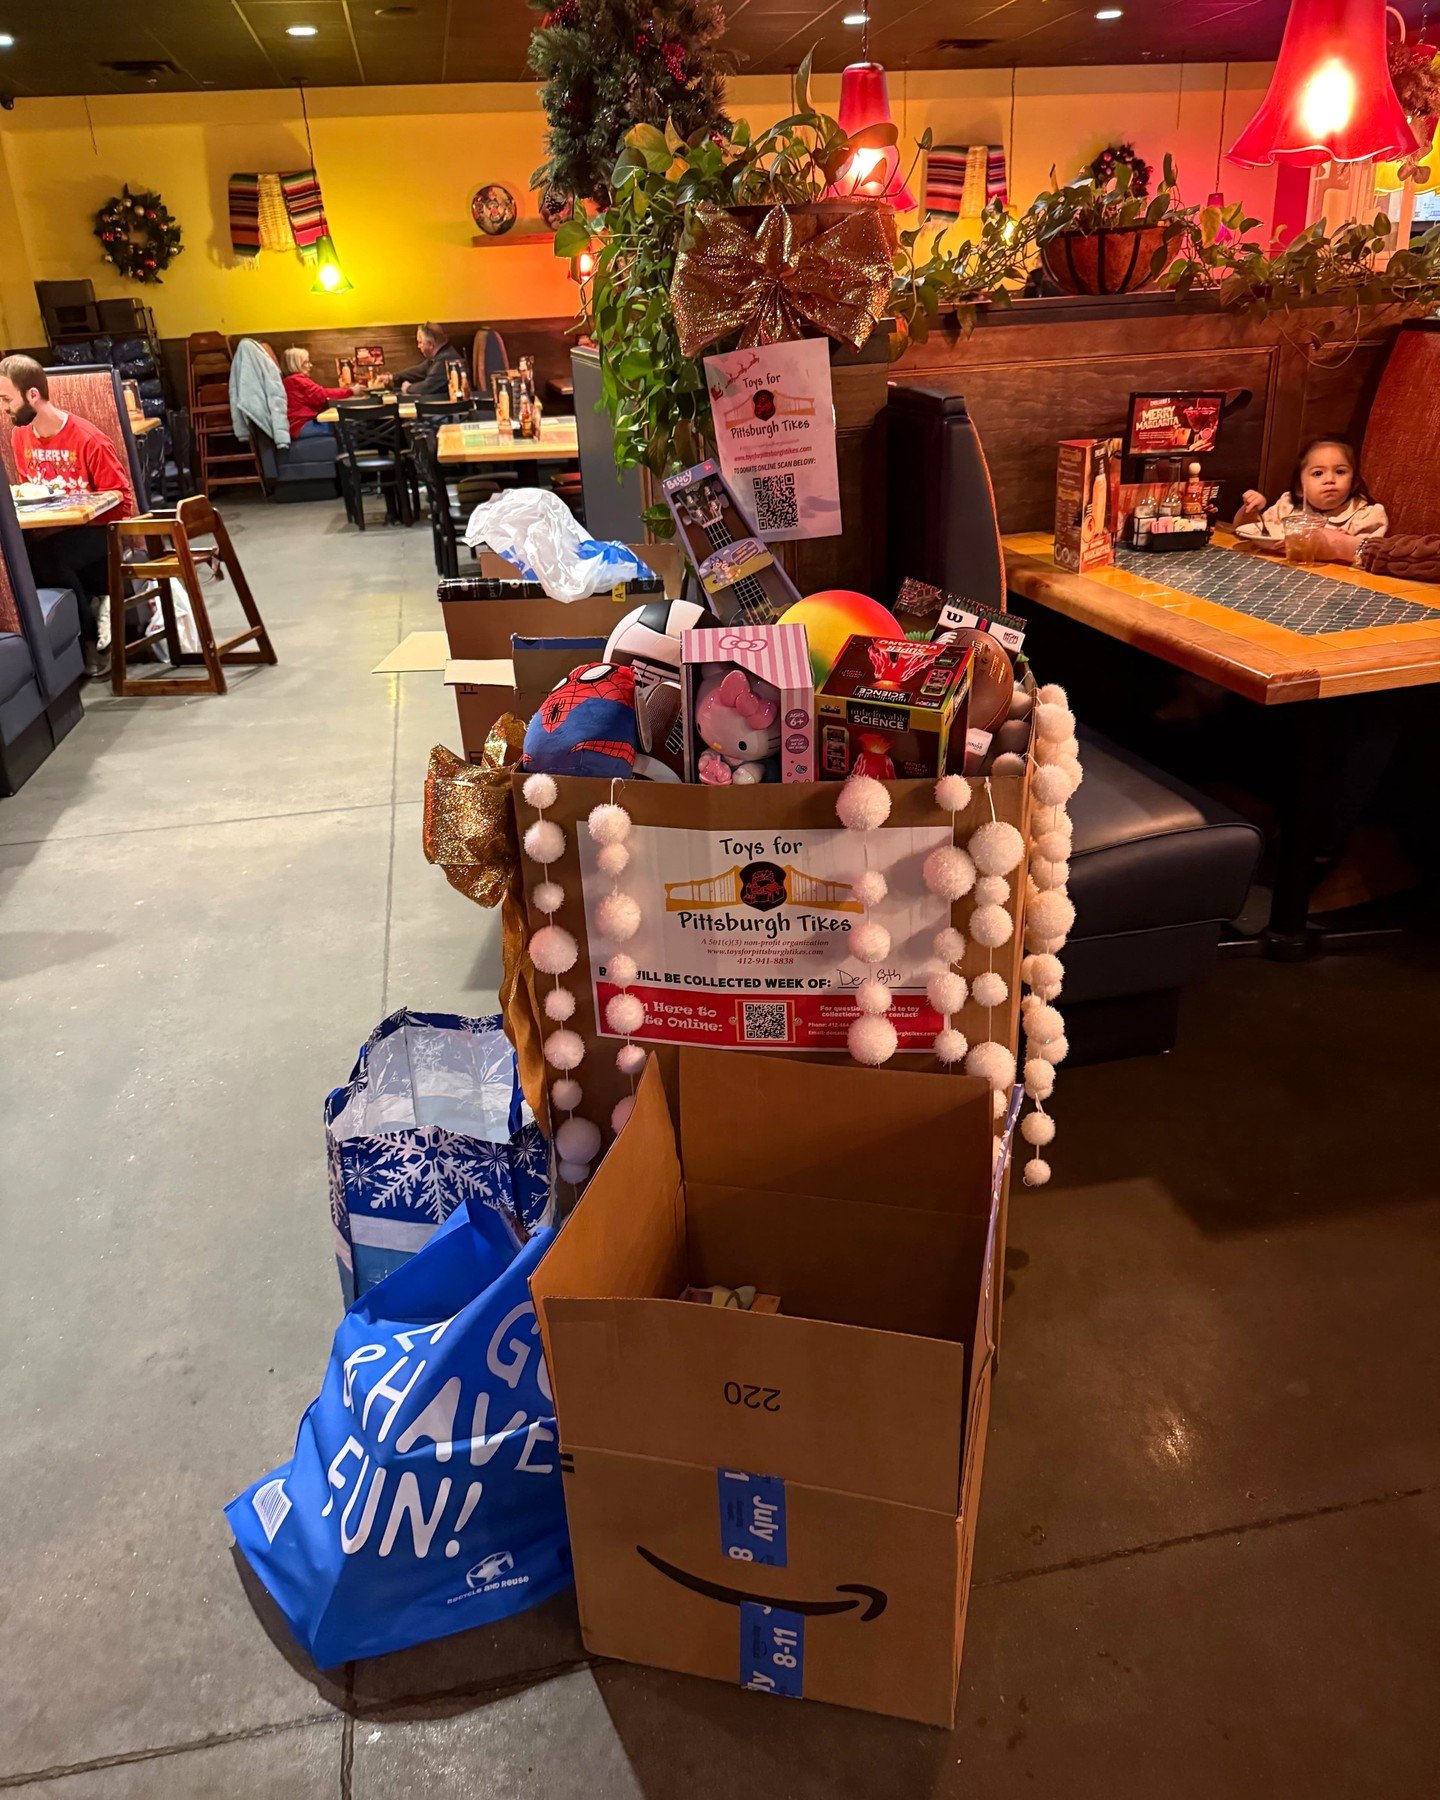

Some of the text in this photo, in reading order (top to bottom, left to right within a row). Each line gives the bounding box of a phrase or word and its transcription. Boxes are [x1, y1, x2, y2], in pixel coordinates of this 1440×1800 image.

[742, 373, 781, 390] Toys for
[1141, 405, 1175, 421] MERRY
[730, 419, 810, 439] Pittsburgh Tikes
[777, 461, 793, 469] SCAN
[859, 688, 906, 699] SCIENCE
[853, 714, 904, 730] SCIENCE
[719, 836, 803, 861] Toys for
[677, 911, 852, 939] Pittsburgh Tikes
[708, 938, 743, 947] 501(c)(3)
[743, 939, 781, 947] non-profit
[782, 939, 829, 947] organization
[707, 948, 824, 957] www.toysforpittsburghtikes.com
[737, 957, 794, 965] 412-941-8838
[664, 973, 681, 984] BE
[683, 975, 762, 988] COLLECTED
[764, 978, 804, 989] WEEK
[807, 978, 831, 989] OF:
[652, 1001, 693, 1016] Here
[697, 1005, 717, 1018] to
[667, 1016, 723, 1032] Online:
[723, 1381, 781, 1412] 220
[362, 1356, 555, 1473] HAVE
[321, 1435, 482, 1558] FUN!
[748, 1495, 779, 1542] July
[772, 1627, 798, 1669] 8-11
